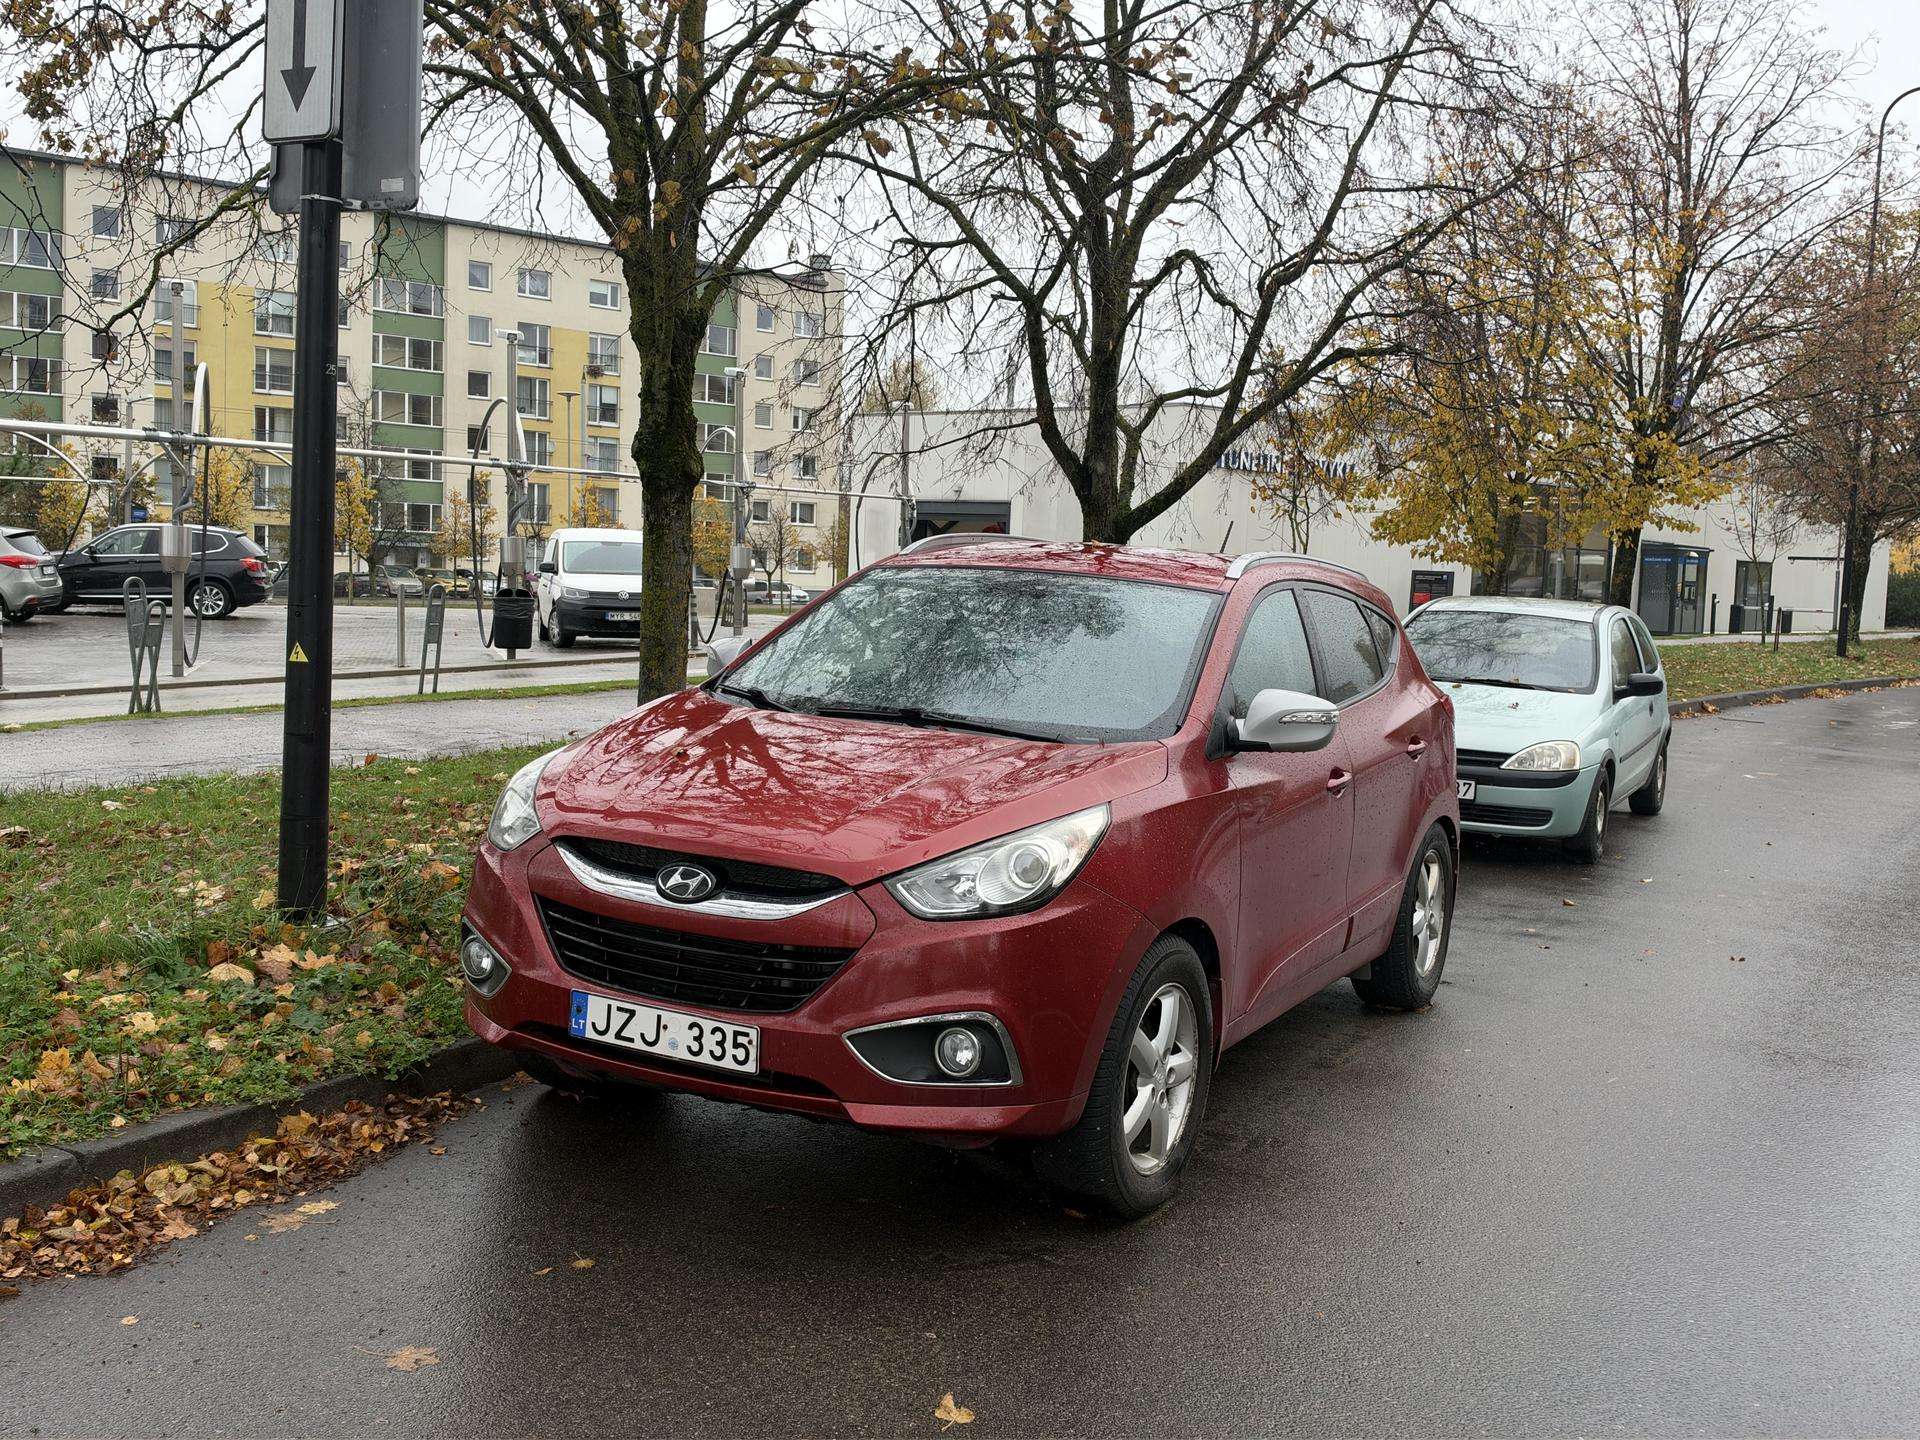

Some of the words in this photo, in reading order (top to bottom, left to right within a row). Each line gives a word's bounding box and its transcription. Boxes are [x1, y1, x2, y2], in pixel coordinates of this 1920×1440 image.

[571, 1019, 586, 1030] LT
[591, 1003, 662, 1048] JZJ
[686, 1021, 751, 1067] 335
